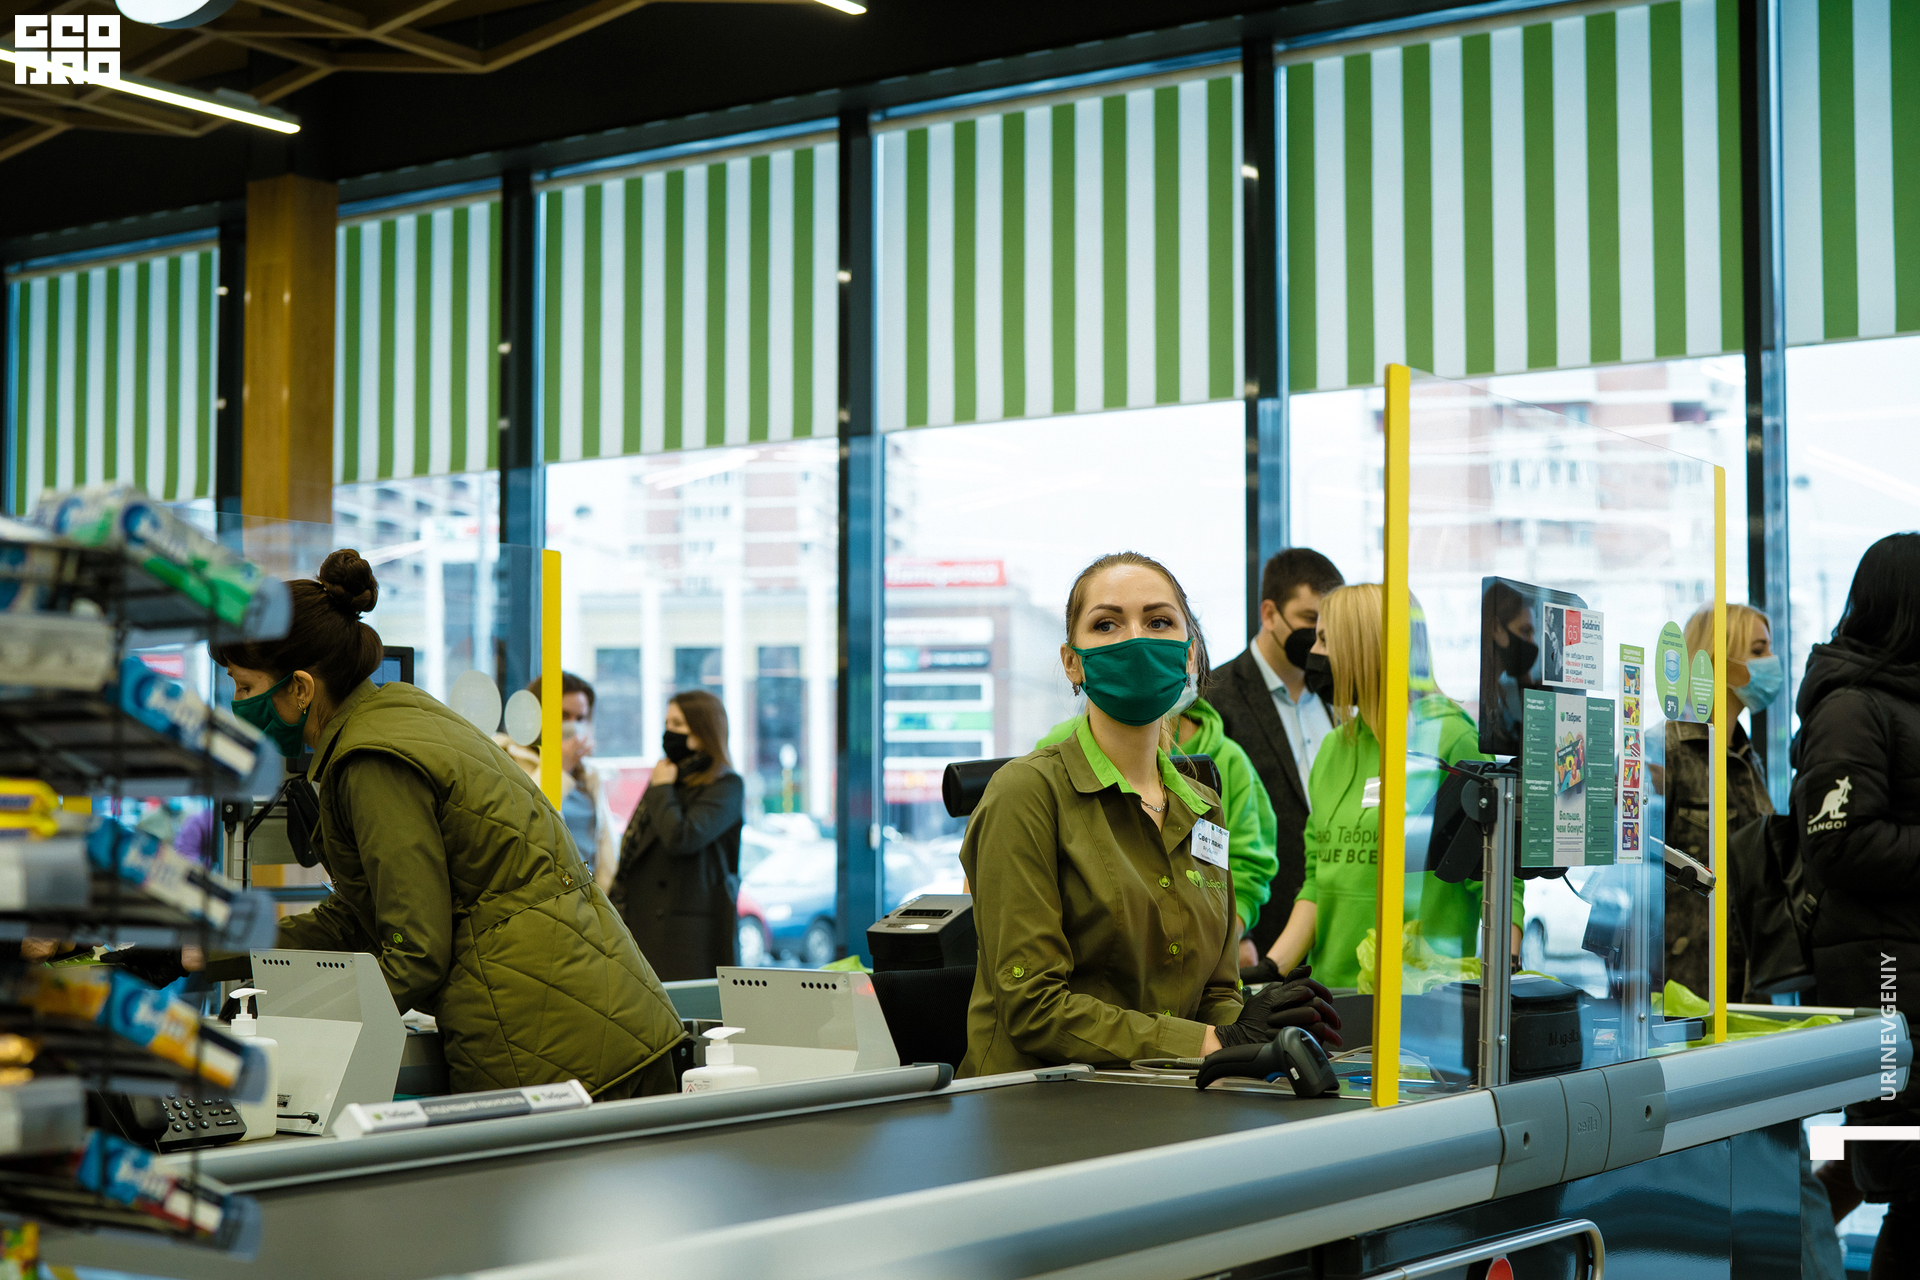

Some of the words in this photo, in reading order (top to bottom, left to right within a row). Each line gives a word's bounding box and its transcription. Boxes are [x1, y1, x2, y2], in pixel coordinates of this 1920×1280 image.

[1566, 712, 1581, 724] Табрис
[1559, 810, 1581, 822] Больше,
[1337, 825, 1379, 847] Табри
[1556, 824, 1566, 833] чем
[1567, 822, 1584, 836] бонус!
[1346, 848, 1378, 865] ВСЕ
